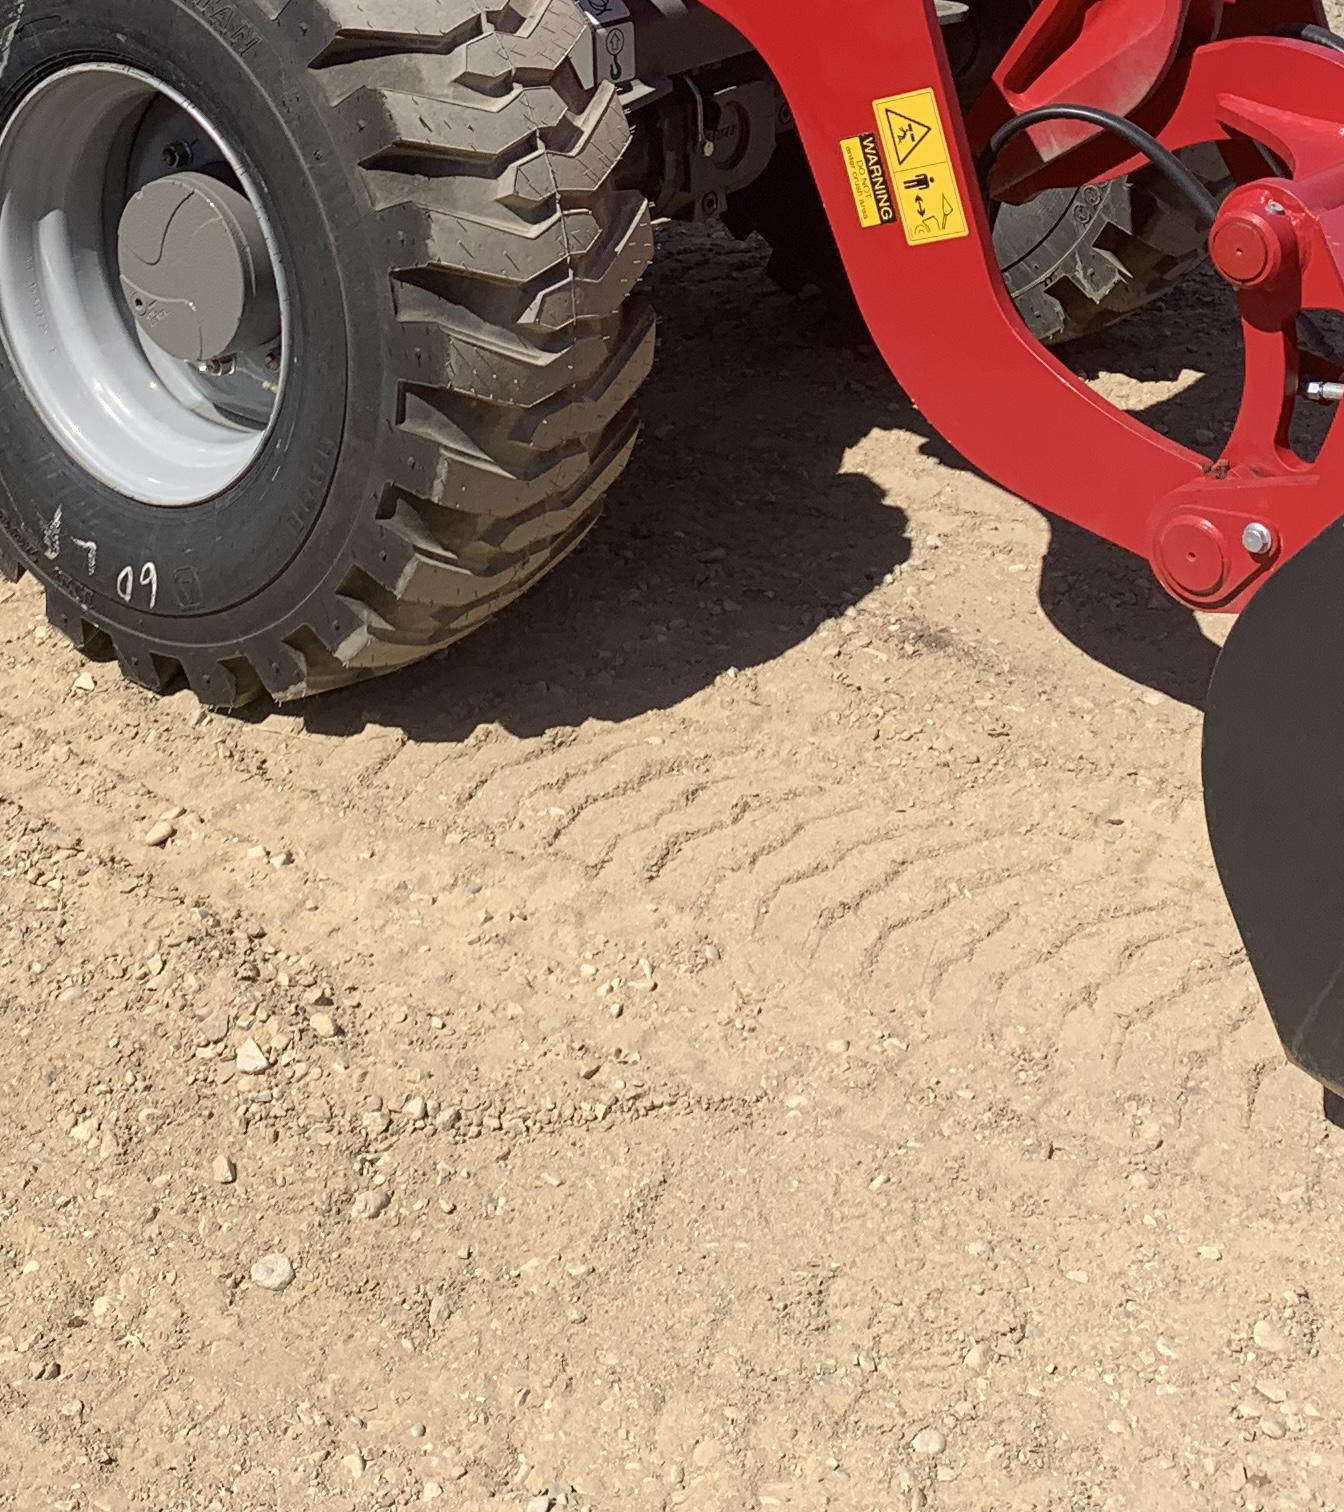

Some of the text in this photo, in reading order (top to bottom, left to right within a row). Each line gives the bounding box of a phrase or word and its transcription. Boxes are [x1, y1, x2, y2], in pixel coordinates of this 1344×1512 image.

[845, 146, 869, 220] enter crush area
[856, 160, 872, 198] DO NOT
[862, 136, 893, 221] WARNING
